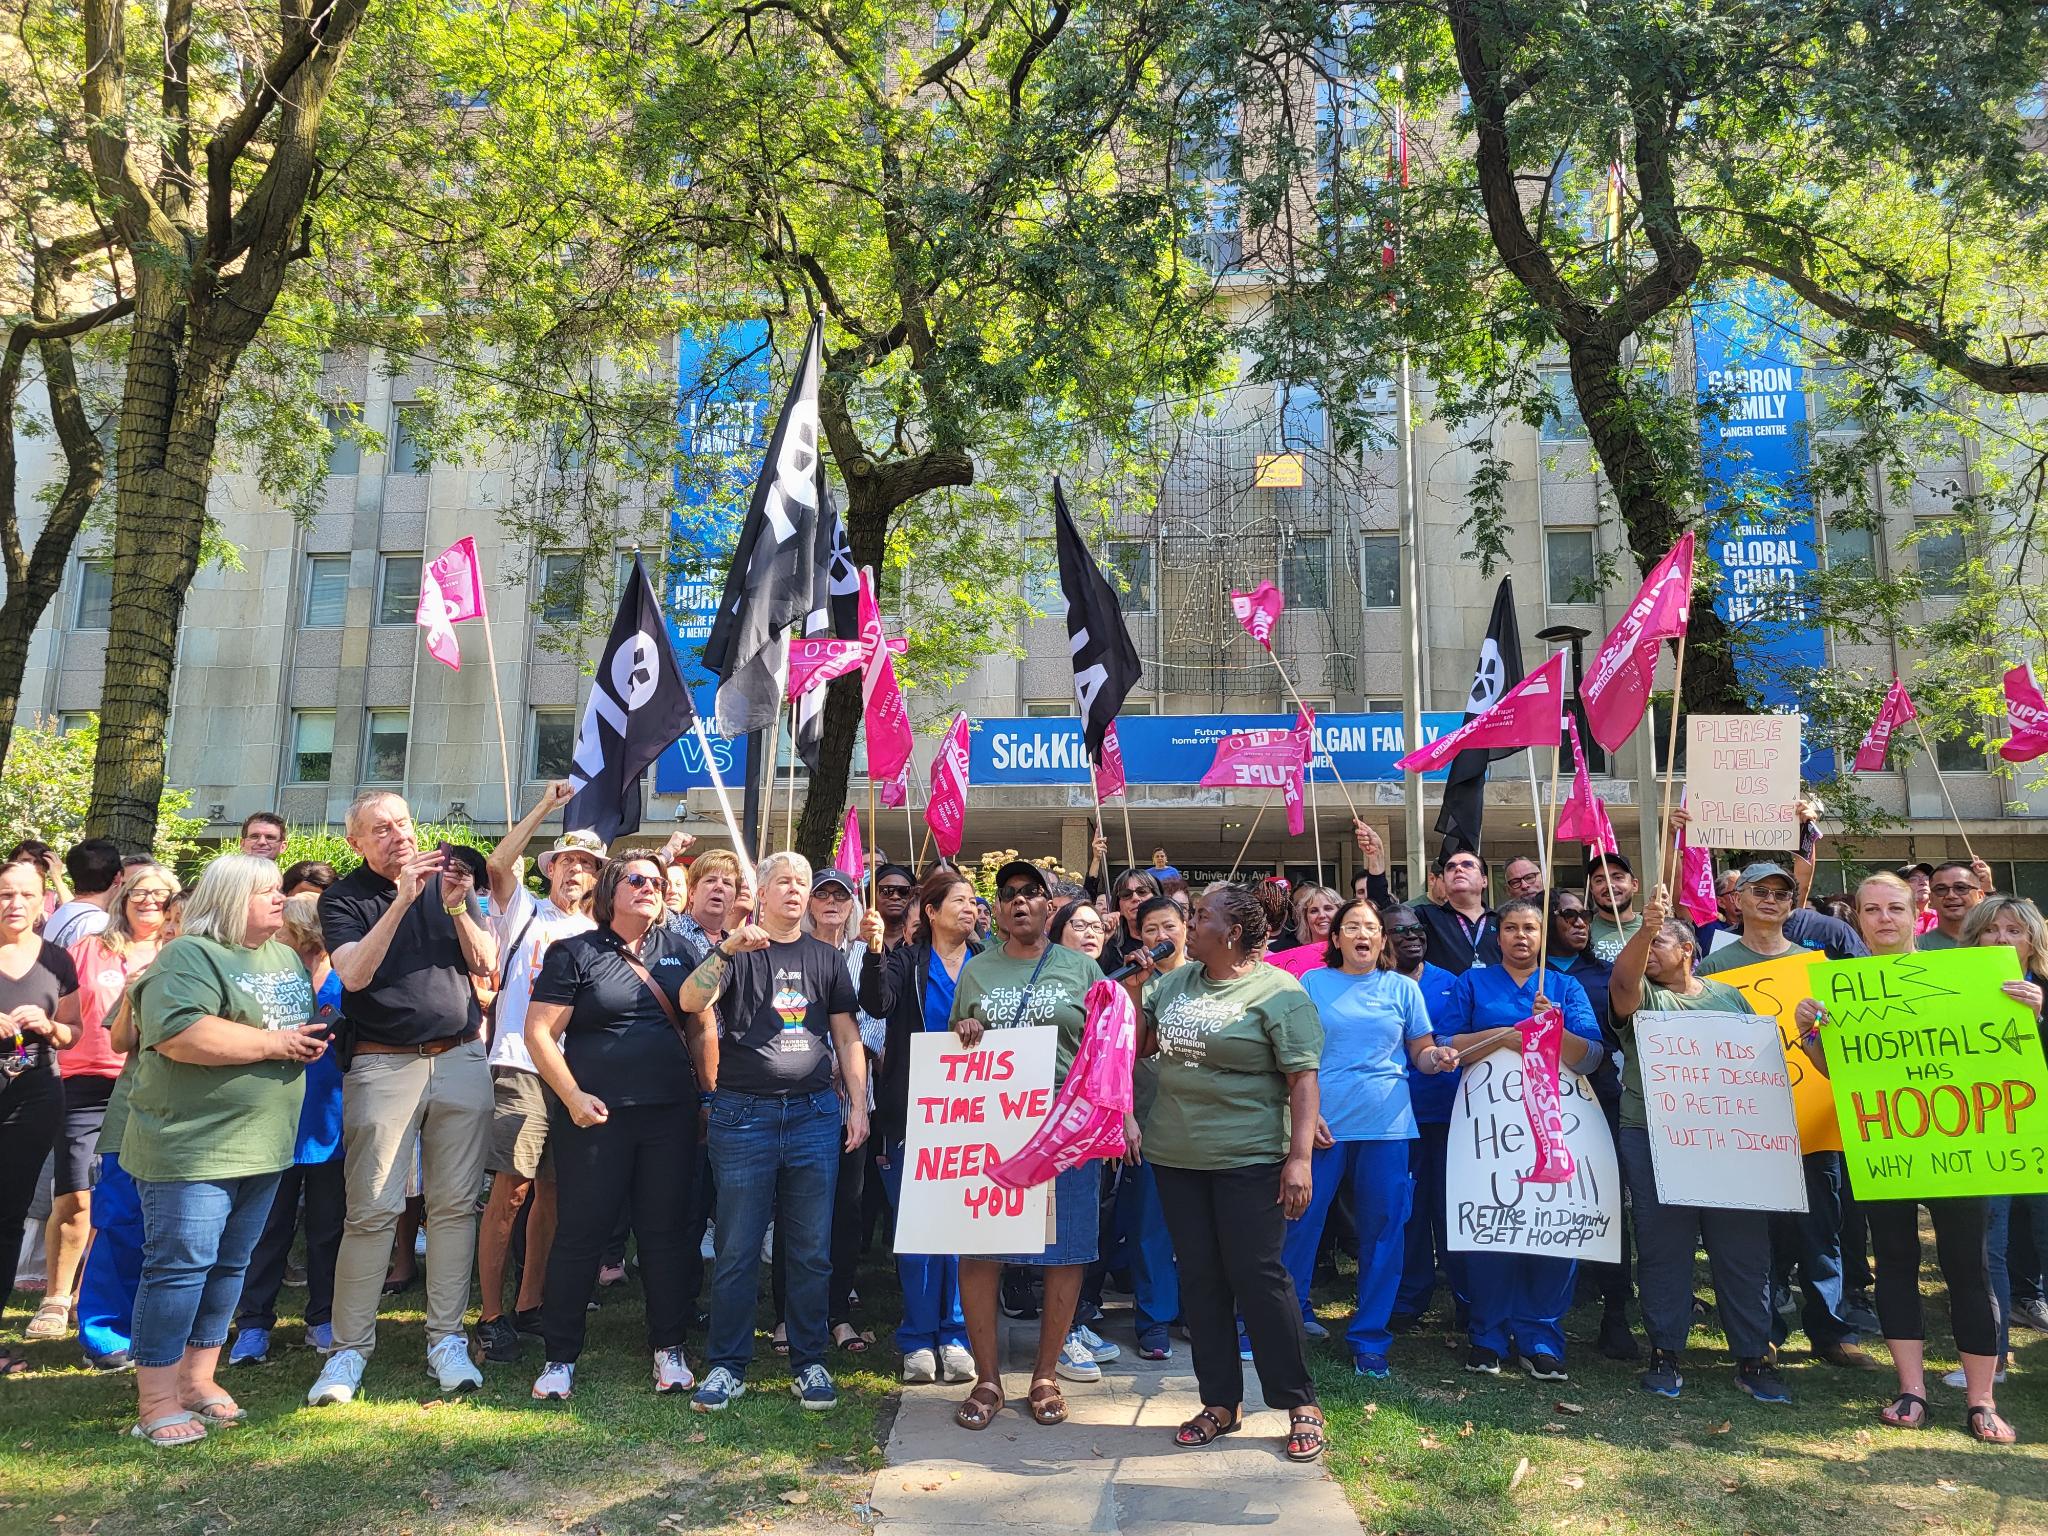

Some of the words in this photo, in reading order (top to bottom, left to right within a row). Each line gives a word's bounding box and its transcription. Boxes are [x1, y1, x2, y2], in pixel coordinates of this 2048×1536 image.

[1724, 394, 1787, 420] AMILY
[1720, 426, 1754, 438] CANCER
[1755, 424, 1788, 437] CENTRE
[1723, 540, 1802, 567] GLOBAL
[1733, 568, 1796, 595] CHILD
[677, 616, 707, 626] ENTRE
[679, 628, 685, 638] &
[1310, 726, 1366, 753] ILGAN
[1372, 726, 1440, 752] FAMY
[1697, 719, 1784, 742] PLEASE
[1714, 749, 1779, 770] HELP
[1736, 776, 1769, 794] US
[1701, 801, 1795, 823] PLEASE
[1697, 828, 1735, 846] WITH
[1744, 830, 1793, 847] HOOPP
[1251, 870, 1271, 881] Ave
[1831, 970, 1903, 1003] ALL
[998, 997, 1057, 1009] wokers
[1167, 1024, 1198, 1040] good
[1173, 1036, 1206, 1050] pension
[1840, 1022, 2002, 1064] HOSPITALS
[1648, 1033, 1701, 1056] SICK
[1714, 1040, 1756, 1060] KIDS
[940, 1050, 1015, 1083] THIS
[1651, 1064, 1711, 1085] STAFF
[1717, 1068, 1786, 1089] DESERVES
[1905, 1063, 1955, 1081] HAS
[917, 1095, 986, 1125] TIME
[998, 1088, 1051, 1121] WE
[1653, 1092, 1676, 1112] TO
[1682, 1093, 1760, 1116] RETIRE
[1851, 1080, 2037, 1142] HOOPP
[1474, 1112, 1581, 1160] Hep
[1662, 1125, 1726, 1150] WITH
[1730, 1128, 1799, 1156] DIGNITY
[915, 1142, 1004, 1181] NEED
[1866, 1154, 1913, 1179] WHY
[1931, 1149, 1973, 1174] NOT
[964, 1186, 1026, 1219] YOU
[1534, 1206, 1553, 1225] in
[1472, 1226, 1523, 1245] GET
[1526, 1227, 1594, 1248] HOOPP
